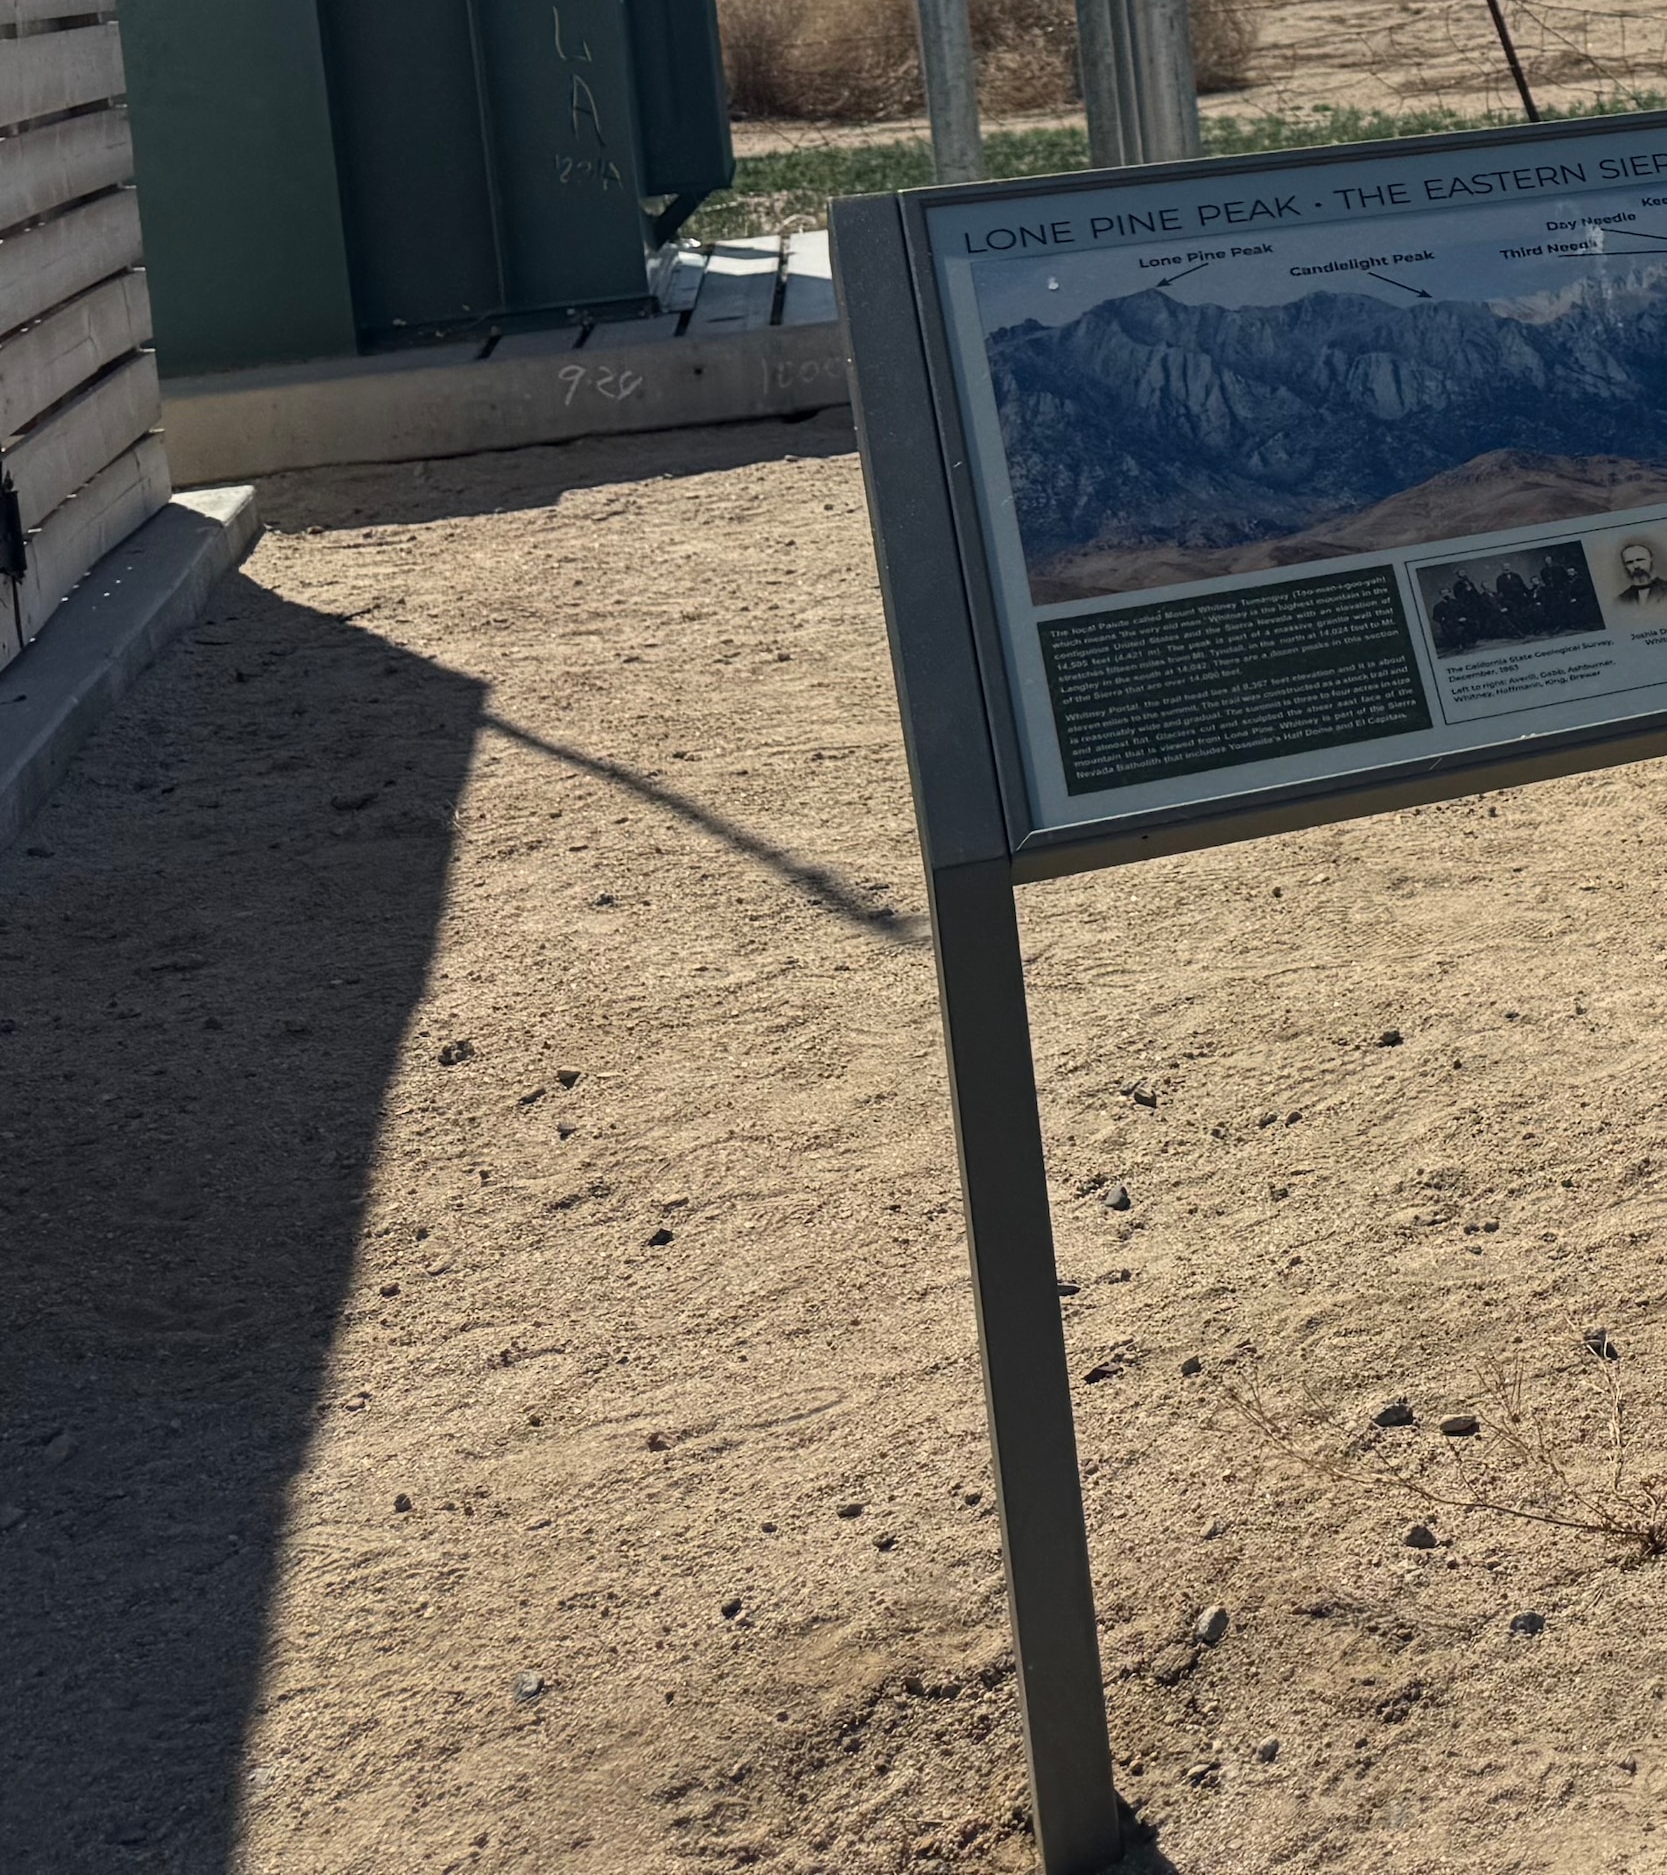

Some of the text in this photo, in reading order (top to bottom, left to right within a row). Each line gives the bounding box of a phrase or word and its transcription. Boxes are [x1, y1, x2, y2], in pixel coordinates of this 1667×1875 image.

[964, 221, 1075, 253] LONE
[1090, 208, 1183, 239] PINE
[1197, 195, 1301, 226] PEAK
[1333, 183, 1412, 209] THE
[1423, 162, 1587, 200] EASTERN
[1545, 220, 1577, 230] Day
[1138, 243, 1273, 268] Lone Pine Peak
[1289, 250, 1435, 276] Candlelight Peak
[1499, 245, 1543, 259] Third
